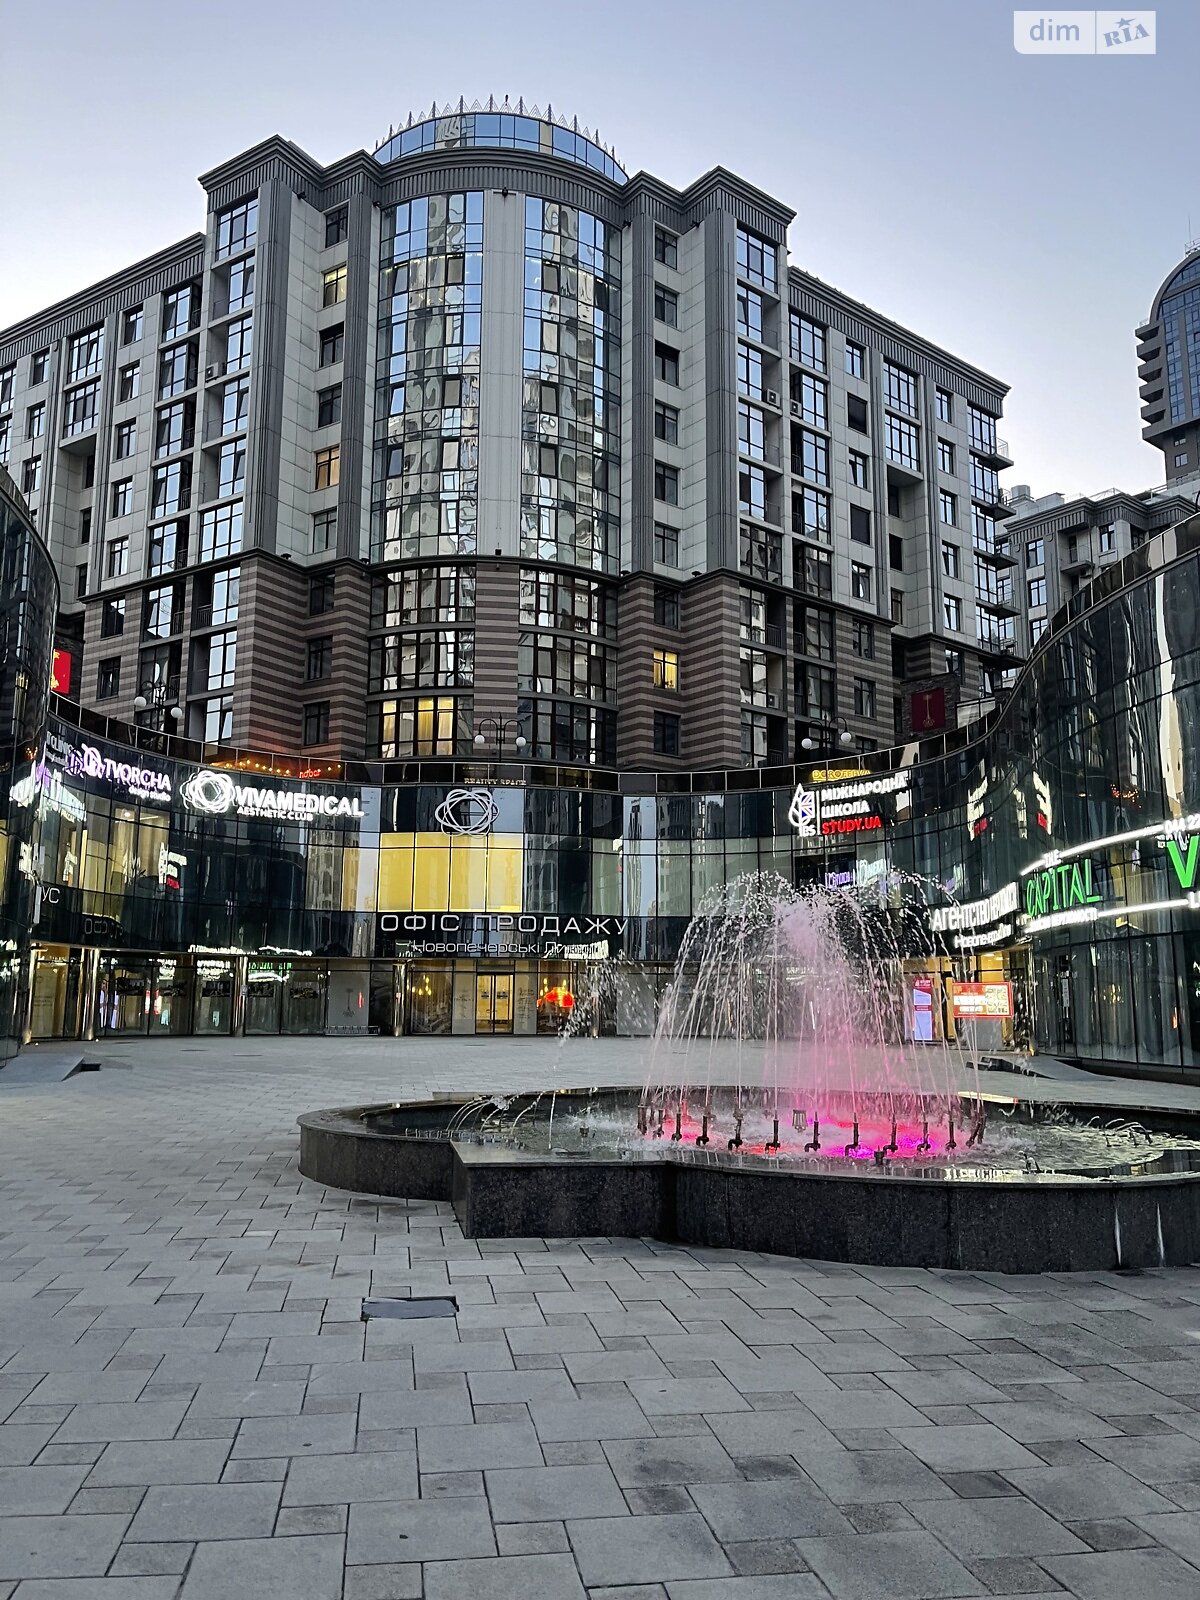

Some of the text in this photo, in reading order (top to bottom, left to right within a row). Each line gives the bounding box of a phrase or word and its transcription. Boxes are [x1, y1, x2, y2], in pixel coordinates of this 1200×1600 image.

[103, 758, 172, 792] TVORCHA
[128, 785, 172, 802] design studio
[821, 778, 908, 801] МІЖНАРОДНА
[235, 785, 365, 818] VIVAMEDICAL
[821, 800, 871, 818] ШКОЛА
[237, 806, 314, 822] AESTHETIC CLUB
[822, 815, 882, 835] STUDY.UA
[1027, 859, 1102, 917] CAPITAL
[381, 914, 629, 937] ОФІС ПРОДАЖУ
[413, 940, 540, 957] Новопечерські
